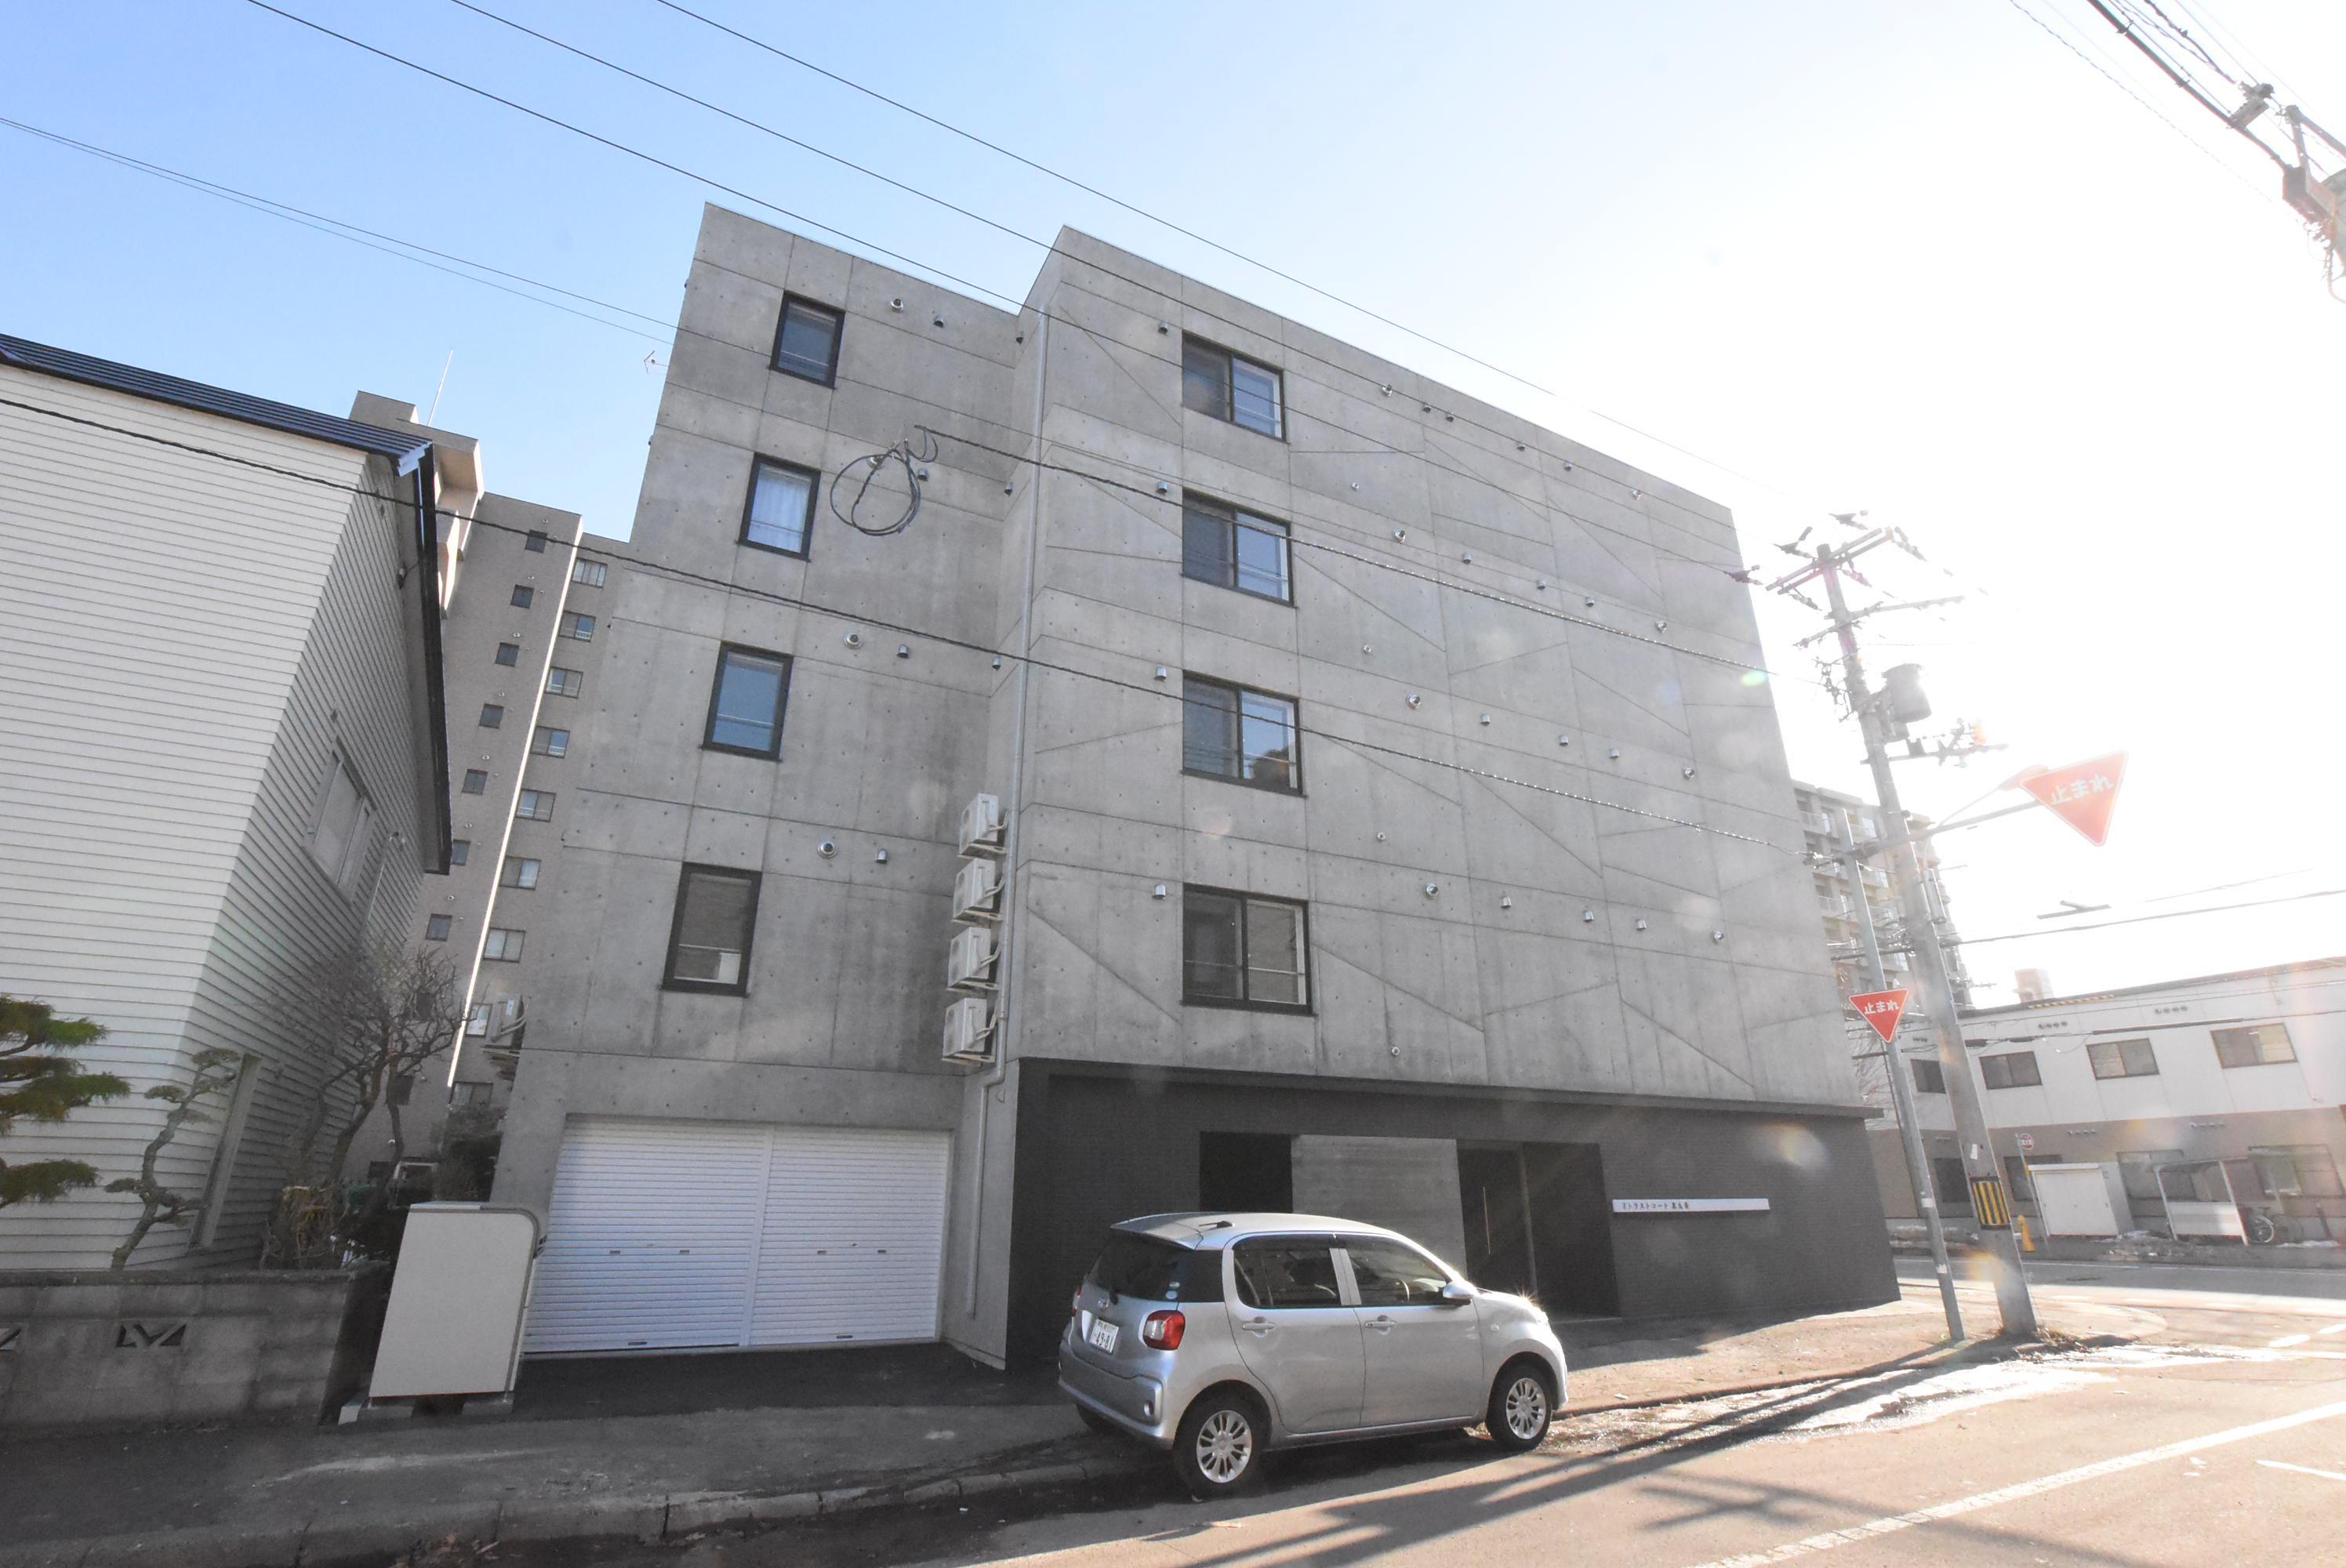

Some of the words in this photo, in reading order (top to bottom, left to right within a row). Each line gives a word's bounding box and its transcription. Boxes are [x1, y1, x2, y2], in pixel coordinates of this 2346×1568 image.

[2050, 772, 2114, 805] 止まれ
[1864, 999, 1900, 1014] 止まれ
